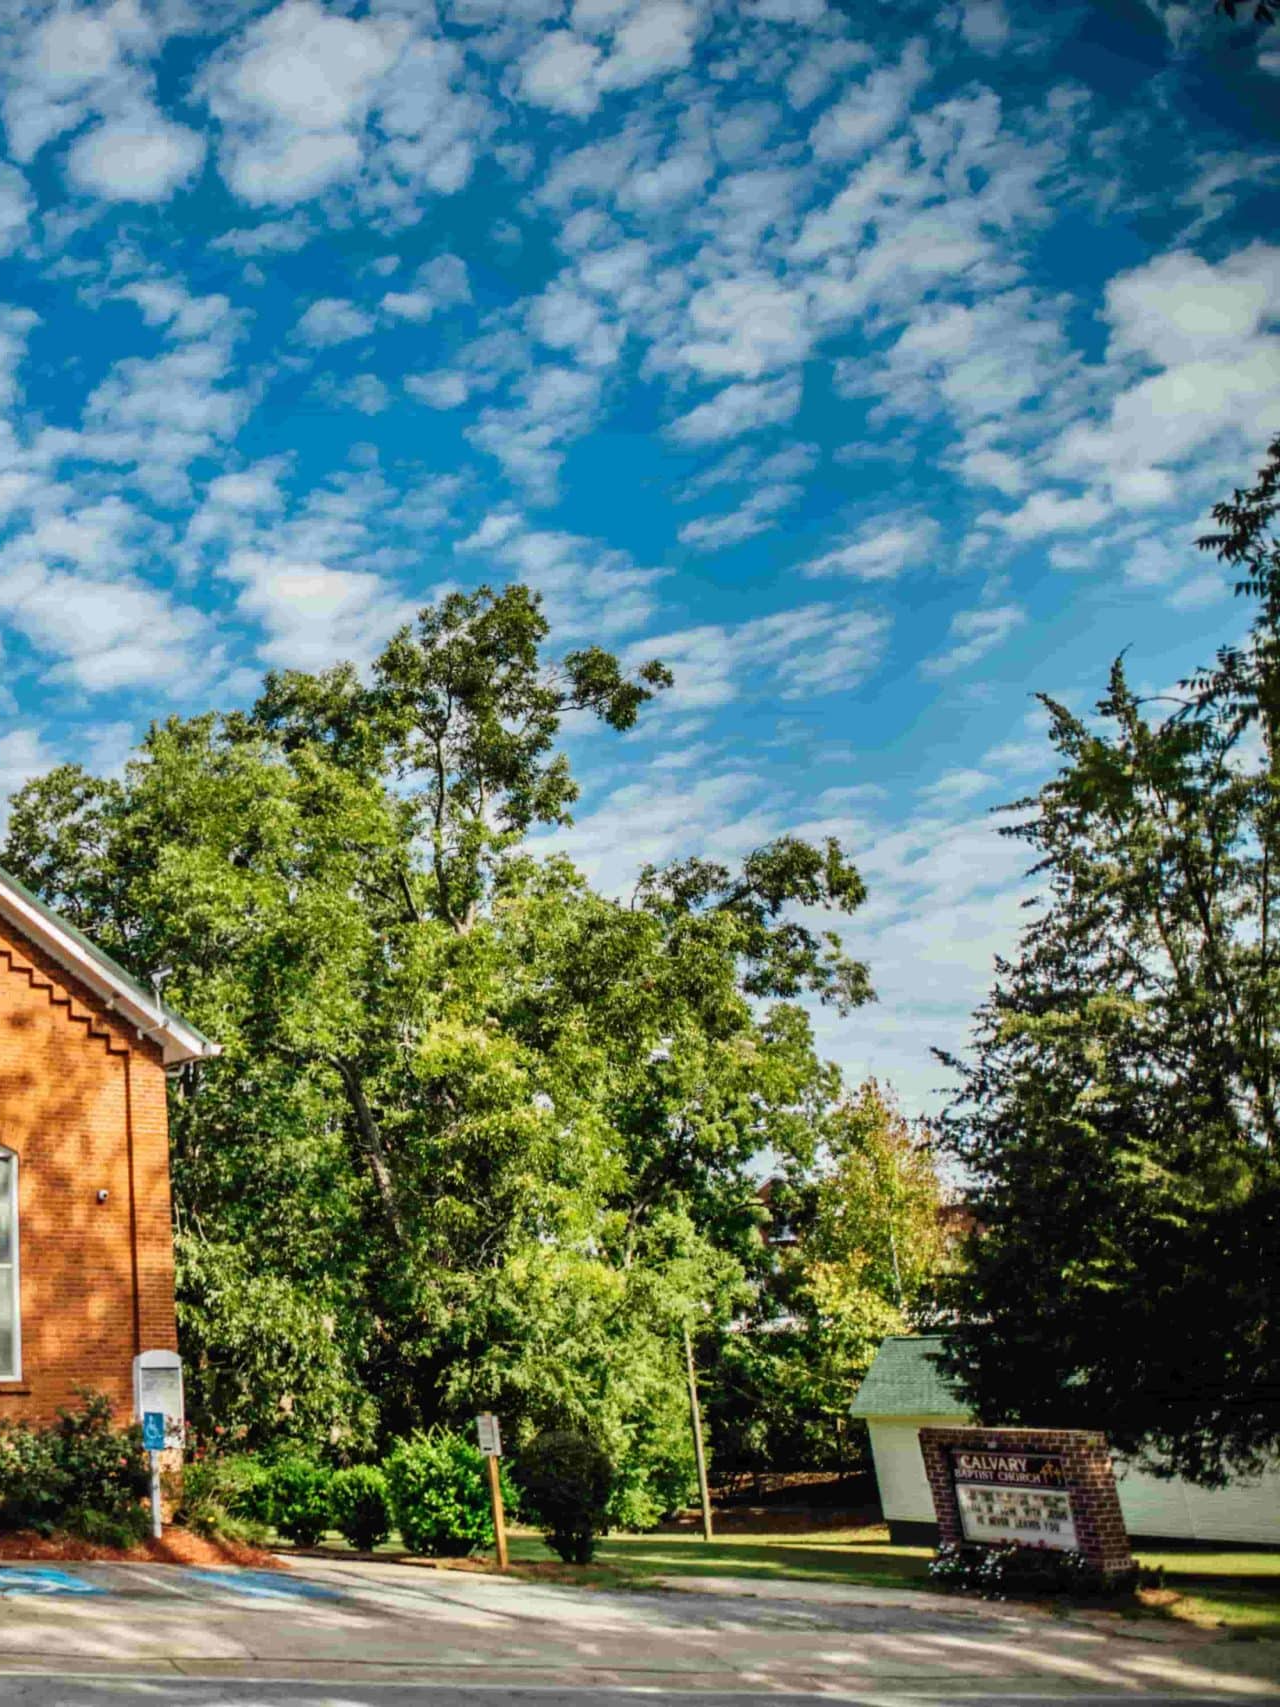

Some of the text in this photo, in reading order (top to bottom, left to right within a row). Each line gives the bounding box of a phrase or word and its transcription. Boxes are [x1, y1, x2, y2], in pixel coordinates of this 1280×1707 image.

[960, 1455, 1027, 1472] CALVARY
[954, 1469, 1041, 1483] BAPTIST CHURCH
[1044, 1521, 1060, 1533] YOU
